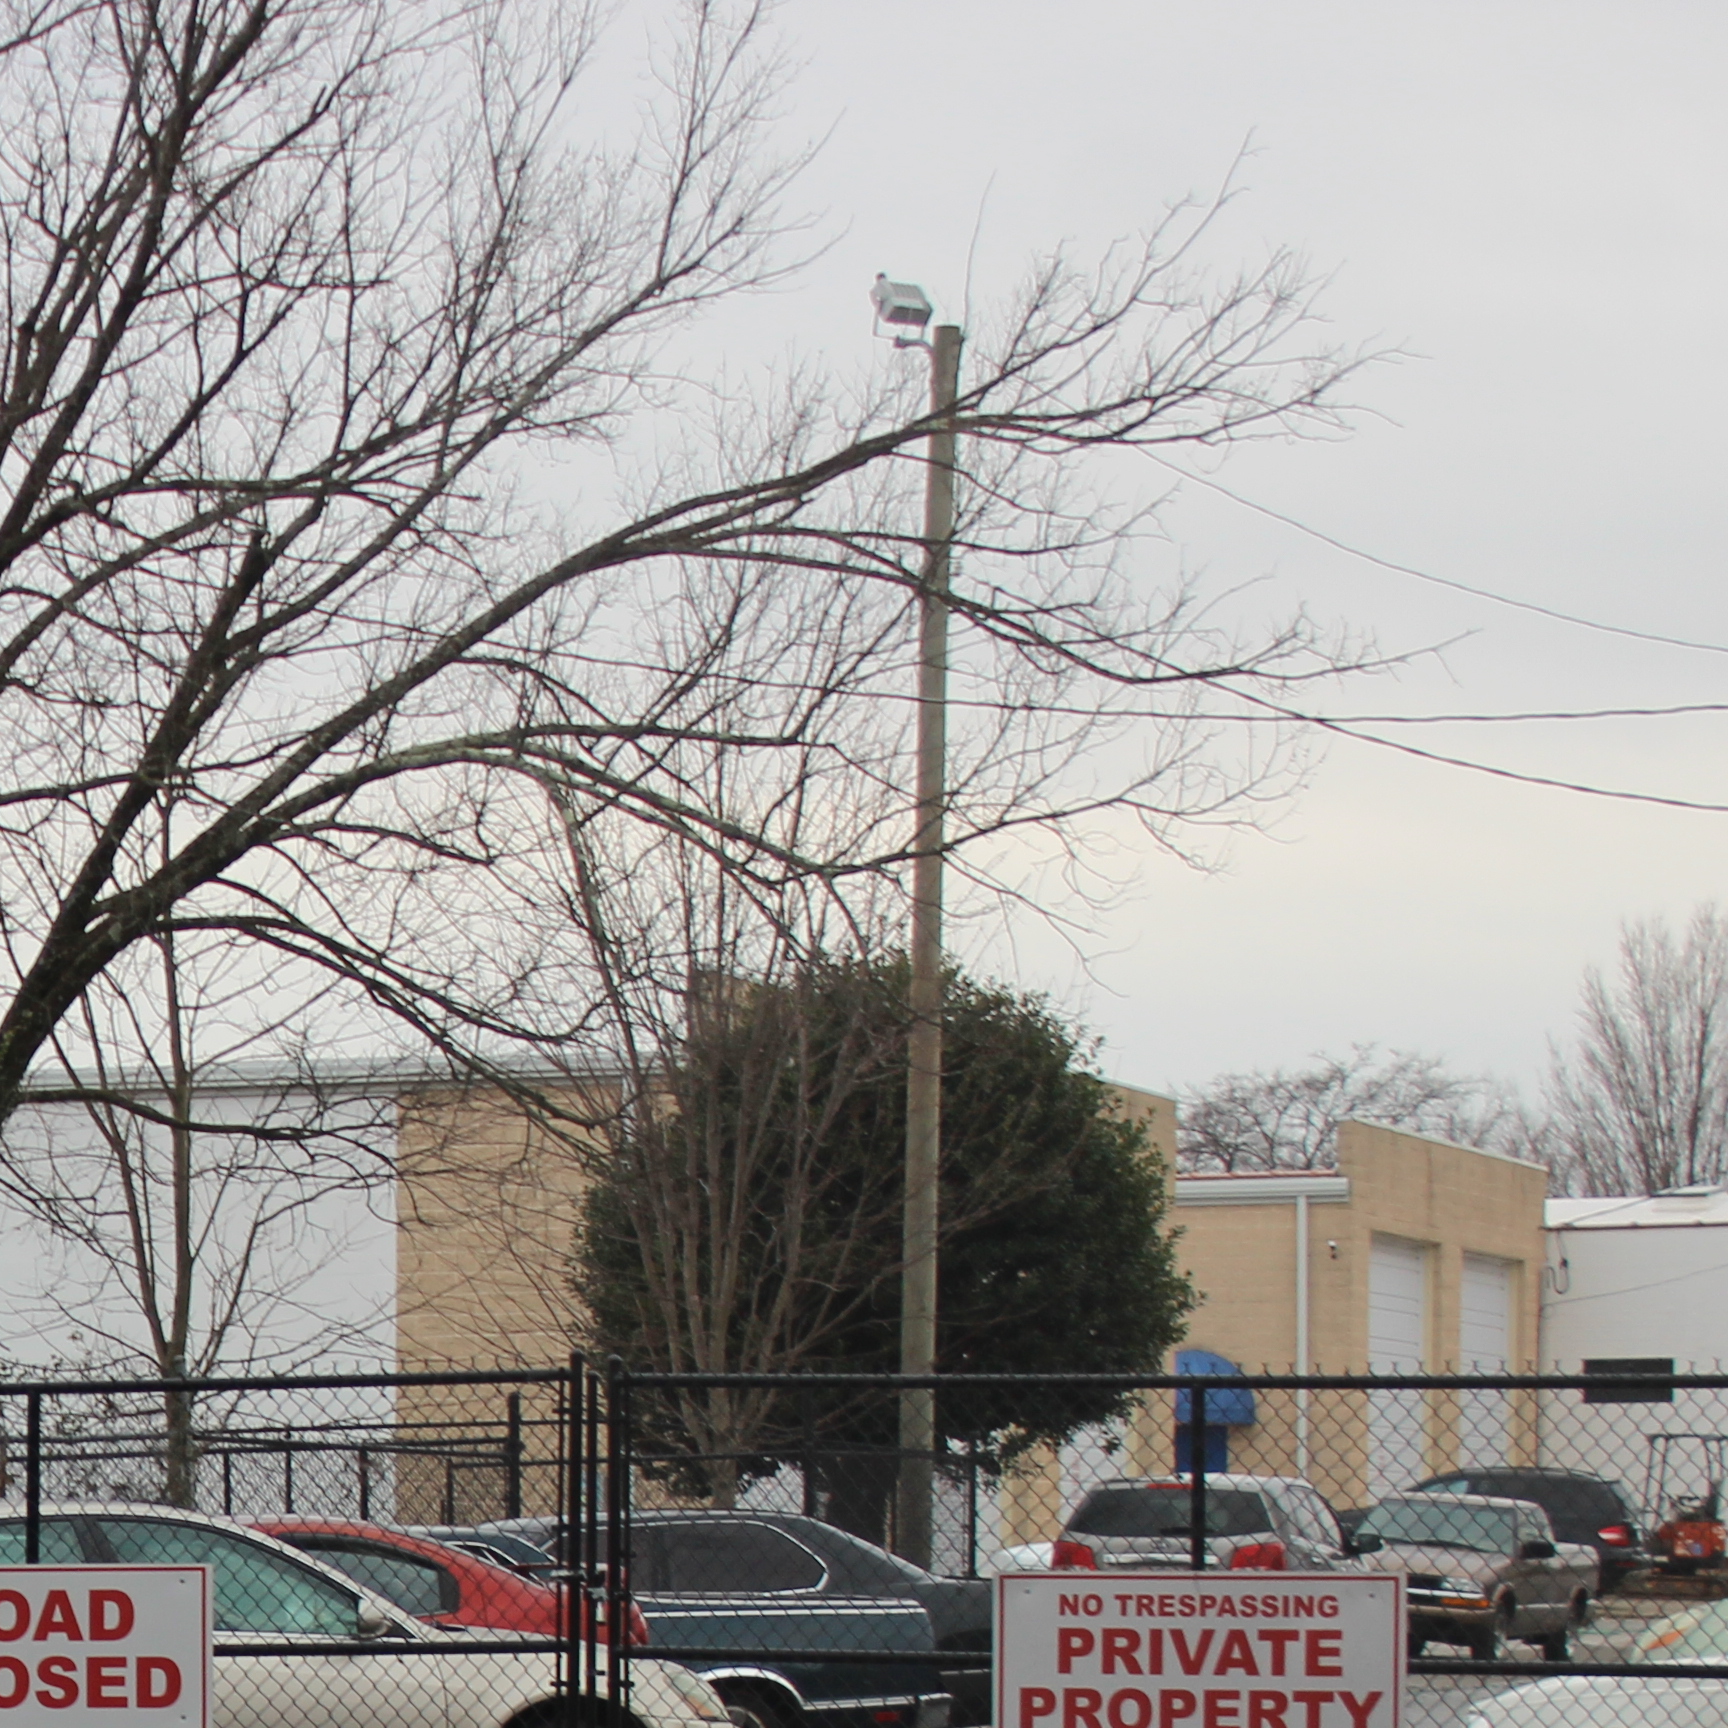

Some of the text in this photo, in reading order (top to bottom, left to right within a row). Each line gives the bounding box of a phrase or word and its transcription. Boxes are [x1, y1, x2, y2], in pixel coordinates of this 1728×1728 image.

[1058, 1593, 1340, 1618] NO TRESPASSING
[1057, 1627, 1343, 1677] PRIVATE
